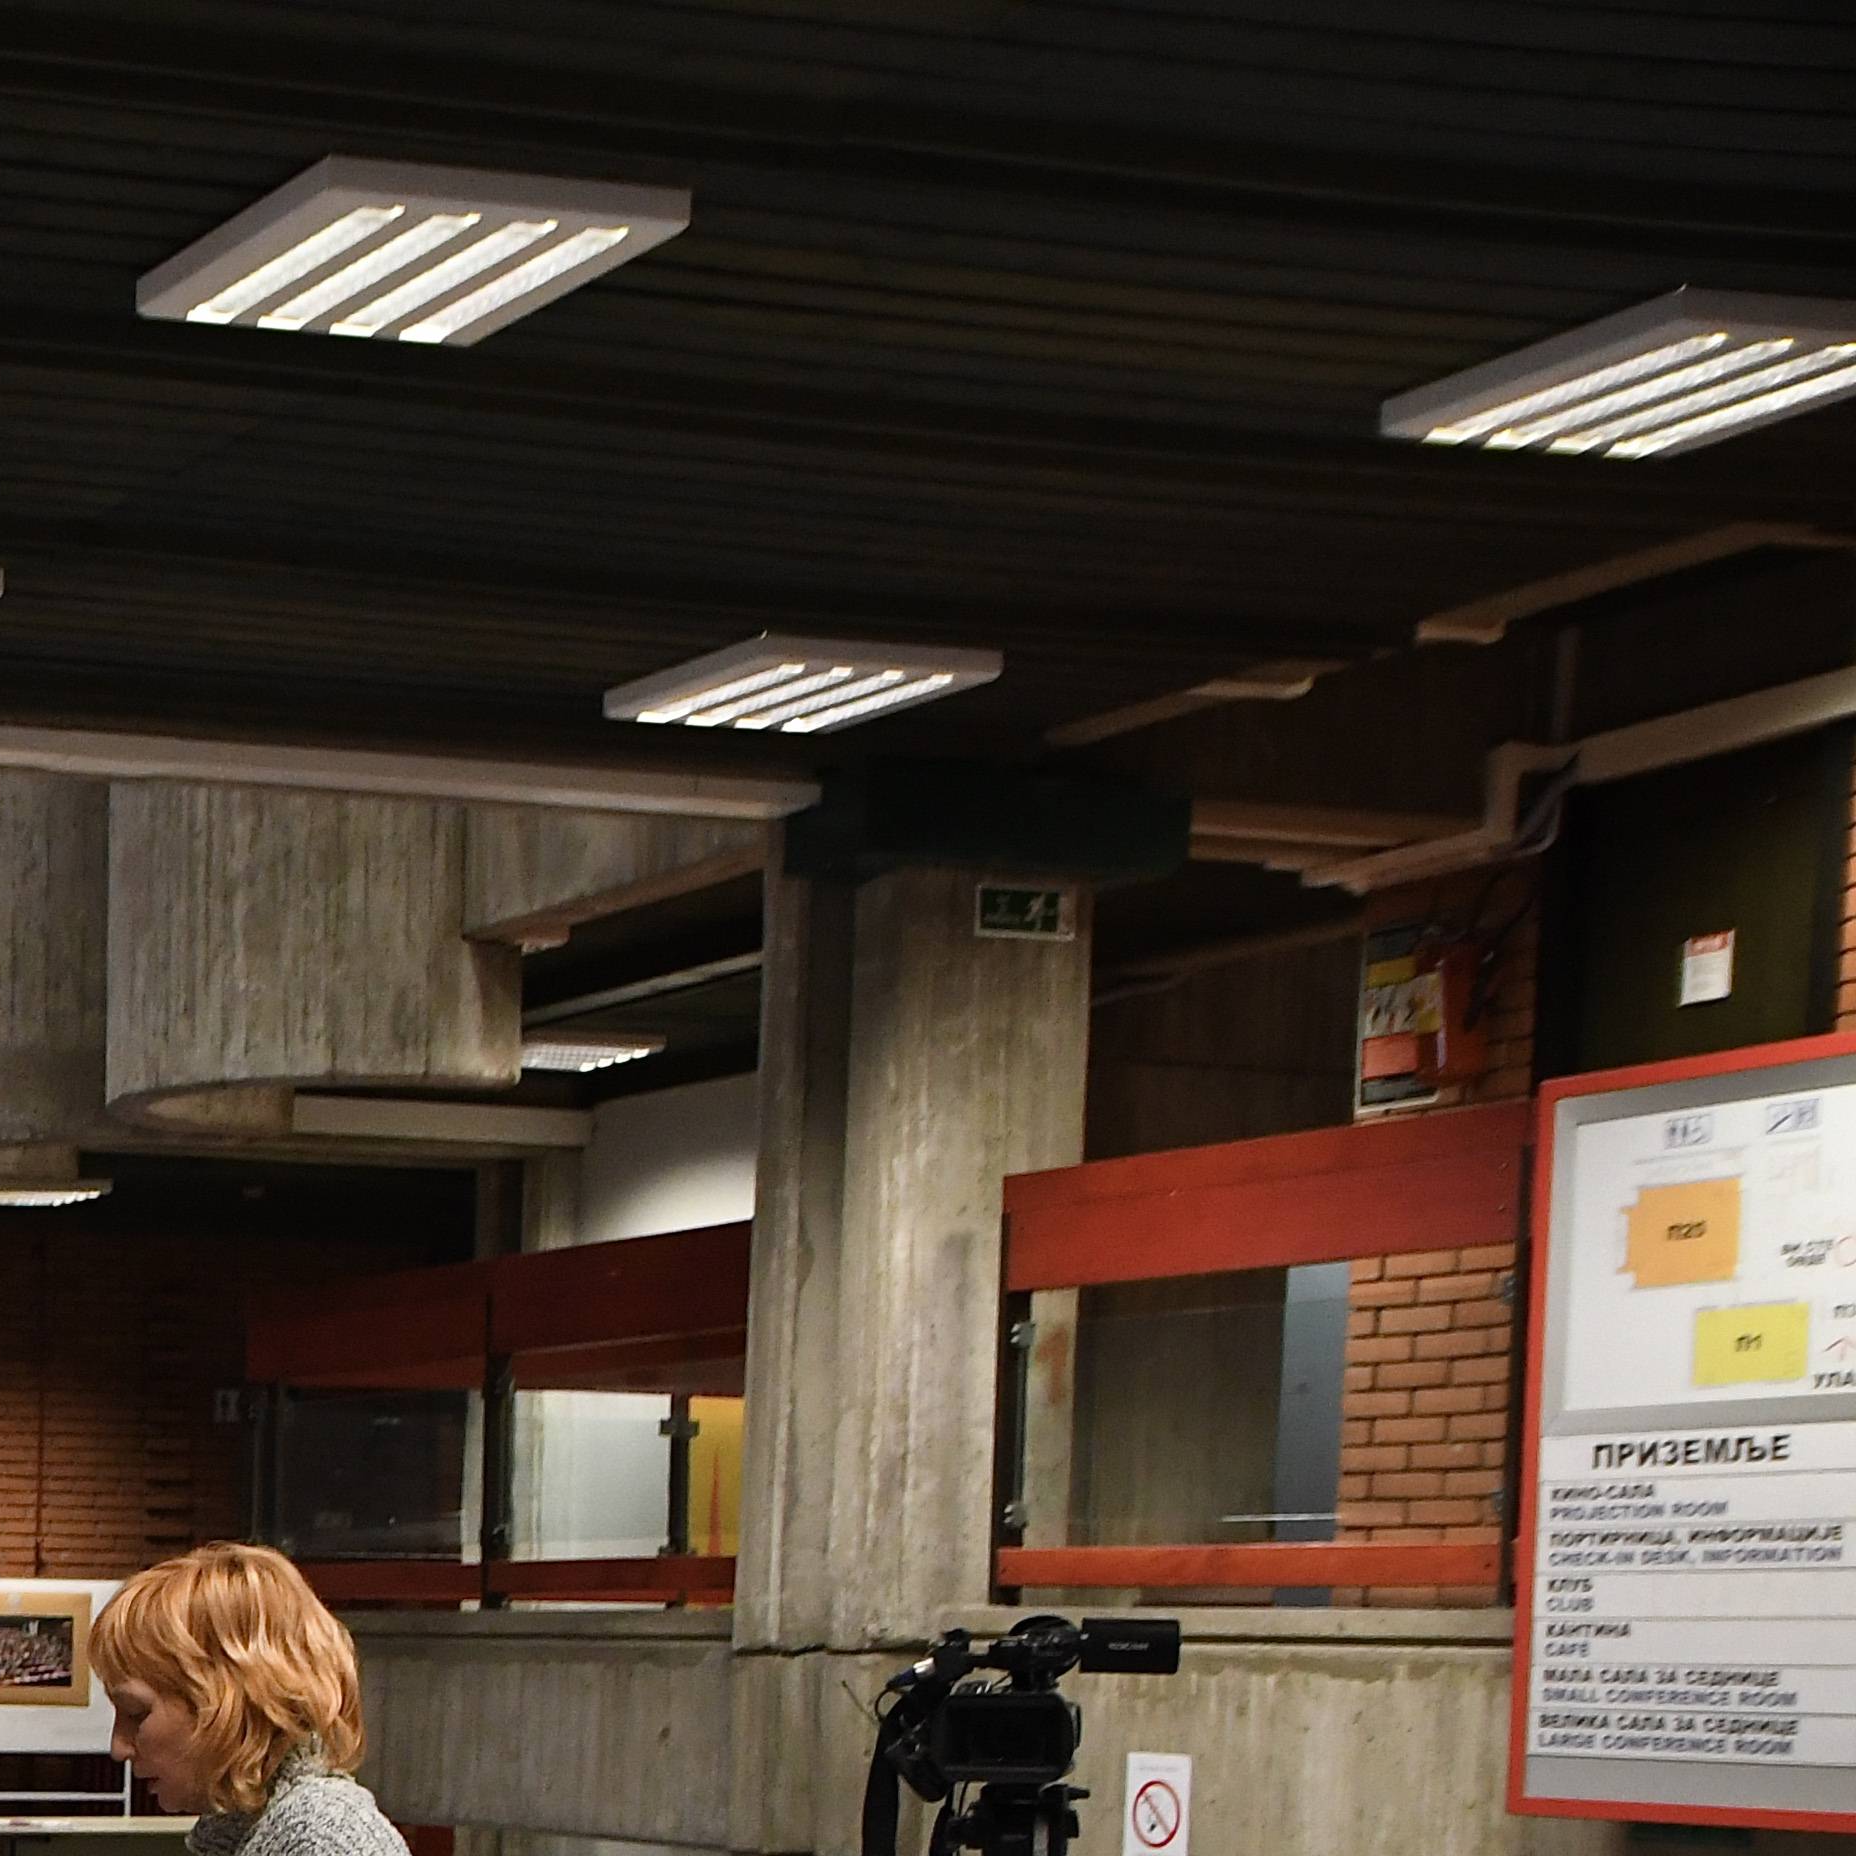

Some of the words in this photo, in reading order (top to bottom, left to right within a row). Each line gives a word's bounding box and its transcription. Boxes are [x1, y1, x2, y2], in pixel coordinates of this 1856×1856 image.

[1591, 1433, 1792, 1470] ПРИЗЕМЉЕ
[1551, 1483, 1655, 1501] КИНО-САЛА
[1550, 1502, 1665, 1521] PROJECTION
[1672, 1500, 1729, 1518] ROOM
[1689, 1525, 1842, 1543] ИНФОРМАЦИЈЕ
[1548, 1549, 1634, 1567] CHECK-IN
[1702, 1546, 1842, 1563] INFORMATION
[1547, 1577, 1594, 1593] КЛУБ
[1546, 1596, 1595, 1613] CLUB
[1545, 1622, 1632, 1639] КАНТИНА
[1543, 1668, 1592, 1683] МАЛА
[1599, 1668, 1649, 1683] САЛА
[1655, 1669, 1677, 1684] ЗА
[1684, 1670, 1779, 1688] СЕДНИЦЕ
[1543, 1687, 1599, 1703] SMALL
[1605, 1688, 1731, 1707] CONFERENCE
[1737, 1690, 1798, 1707] ROOM
[1539, 1713, 1610, 1730] ВЕЛИКА
[1616, 1715, 1667, 1731] САЛА
[1673, 1717, 1695, 1732] ЗА
[1702, 1718, 1800, 1737] СЕДНИЦЕ
[1538, 1732, 1597, 1749] LARGE
[1601, 1734, 1728, 1754] CONFERENCE
[1734, 1737, 1794, 1755] ROOM
